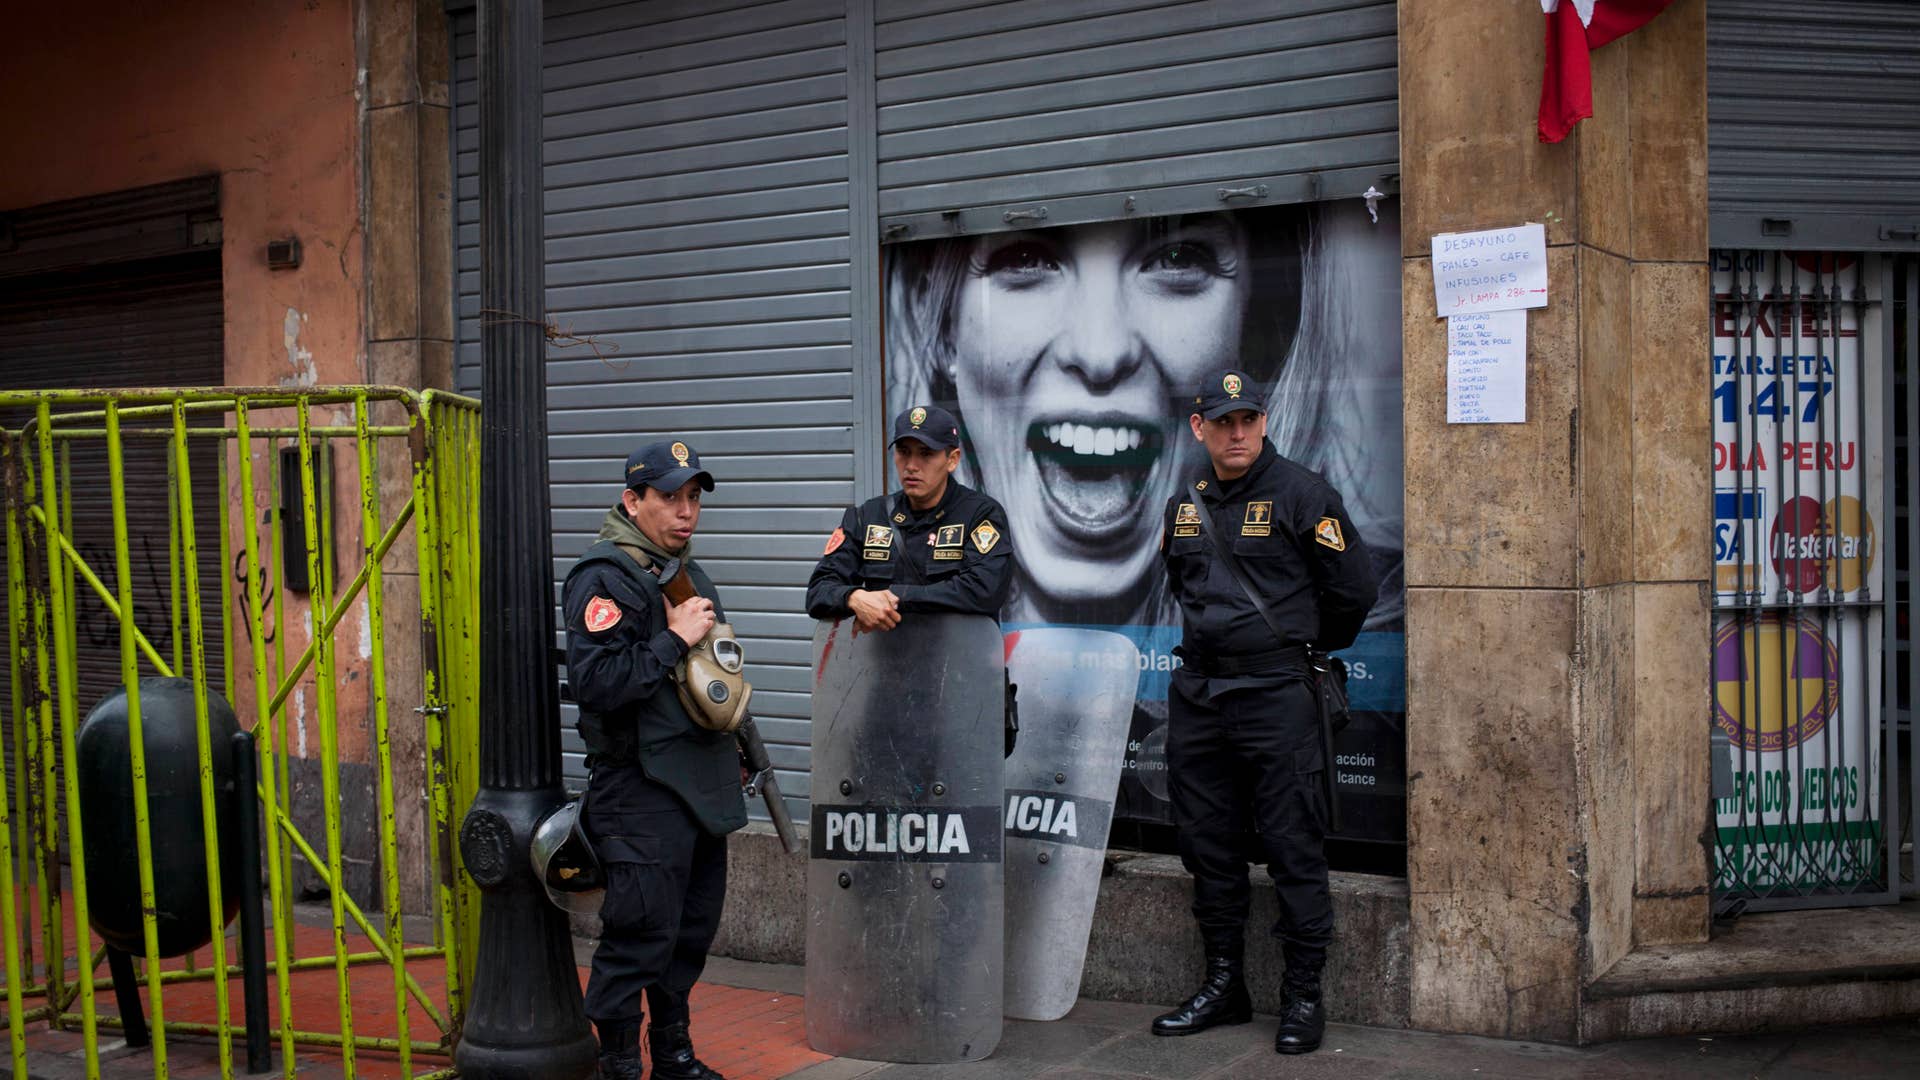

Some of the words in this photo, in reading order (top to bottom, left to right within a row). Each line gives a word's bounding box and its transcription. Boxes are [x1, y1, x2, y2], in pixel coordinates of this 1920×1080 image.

[1444, 233, 1516, 252] DESAYUNO
[1439, 257, 1479, 272] PANES
[1500, 251, 1529, 262] CAFE
[1446, 272, 1517, 289] INFUSIONES
[1471, 292, 1500, 304] LAMPA
[1714, 355, 1834, 375] TARJETA
[1714, 380, 1833, 423] 147
[1782, 441, 1856, 471] PERU
[1336, 753, 1375, 767] acción
[1802, 766, 1858, 810] MEDCOS
[1005, 795, 1078, 838] ICIA
[825, 811, 971, 854] POLICIA
